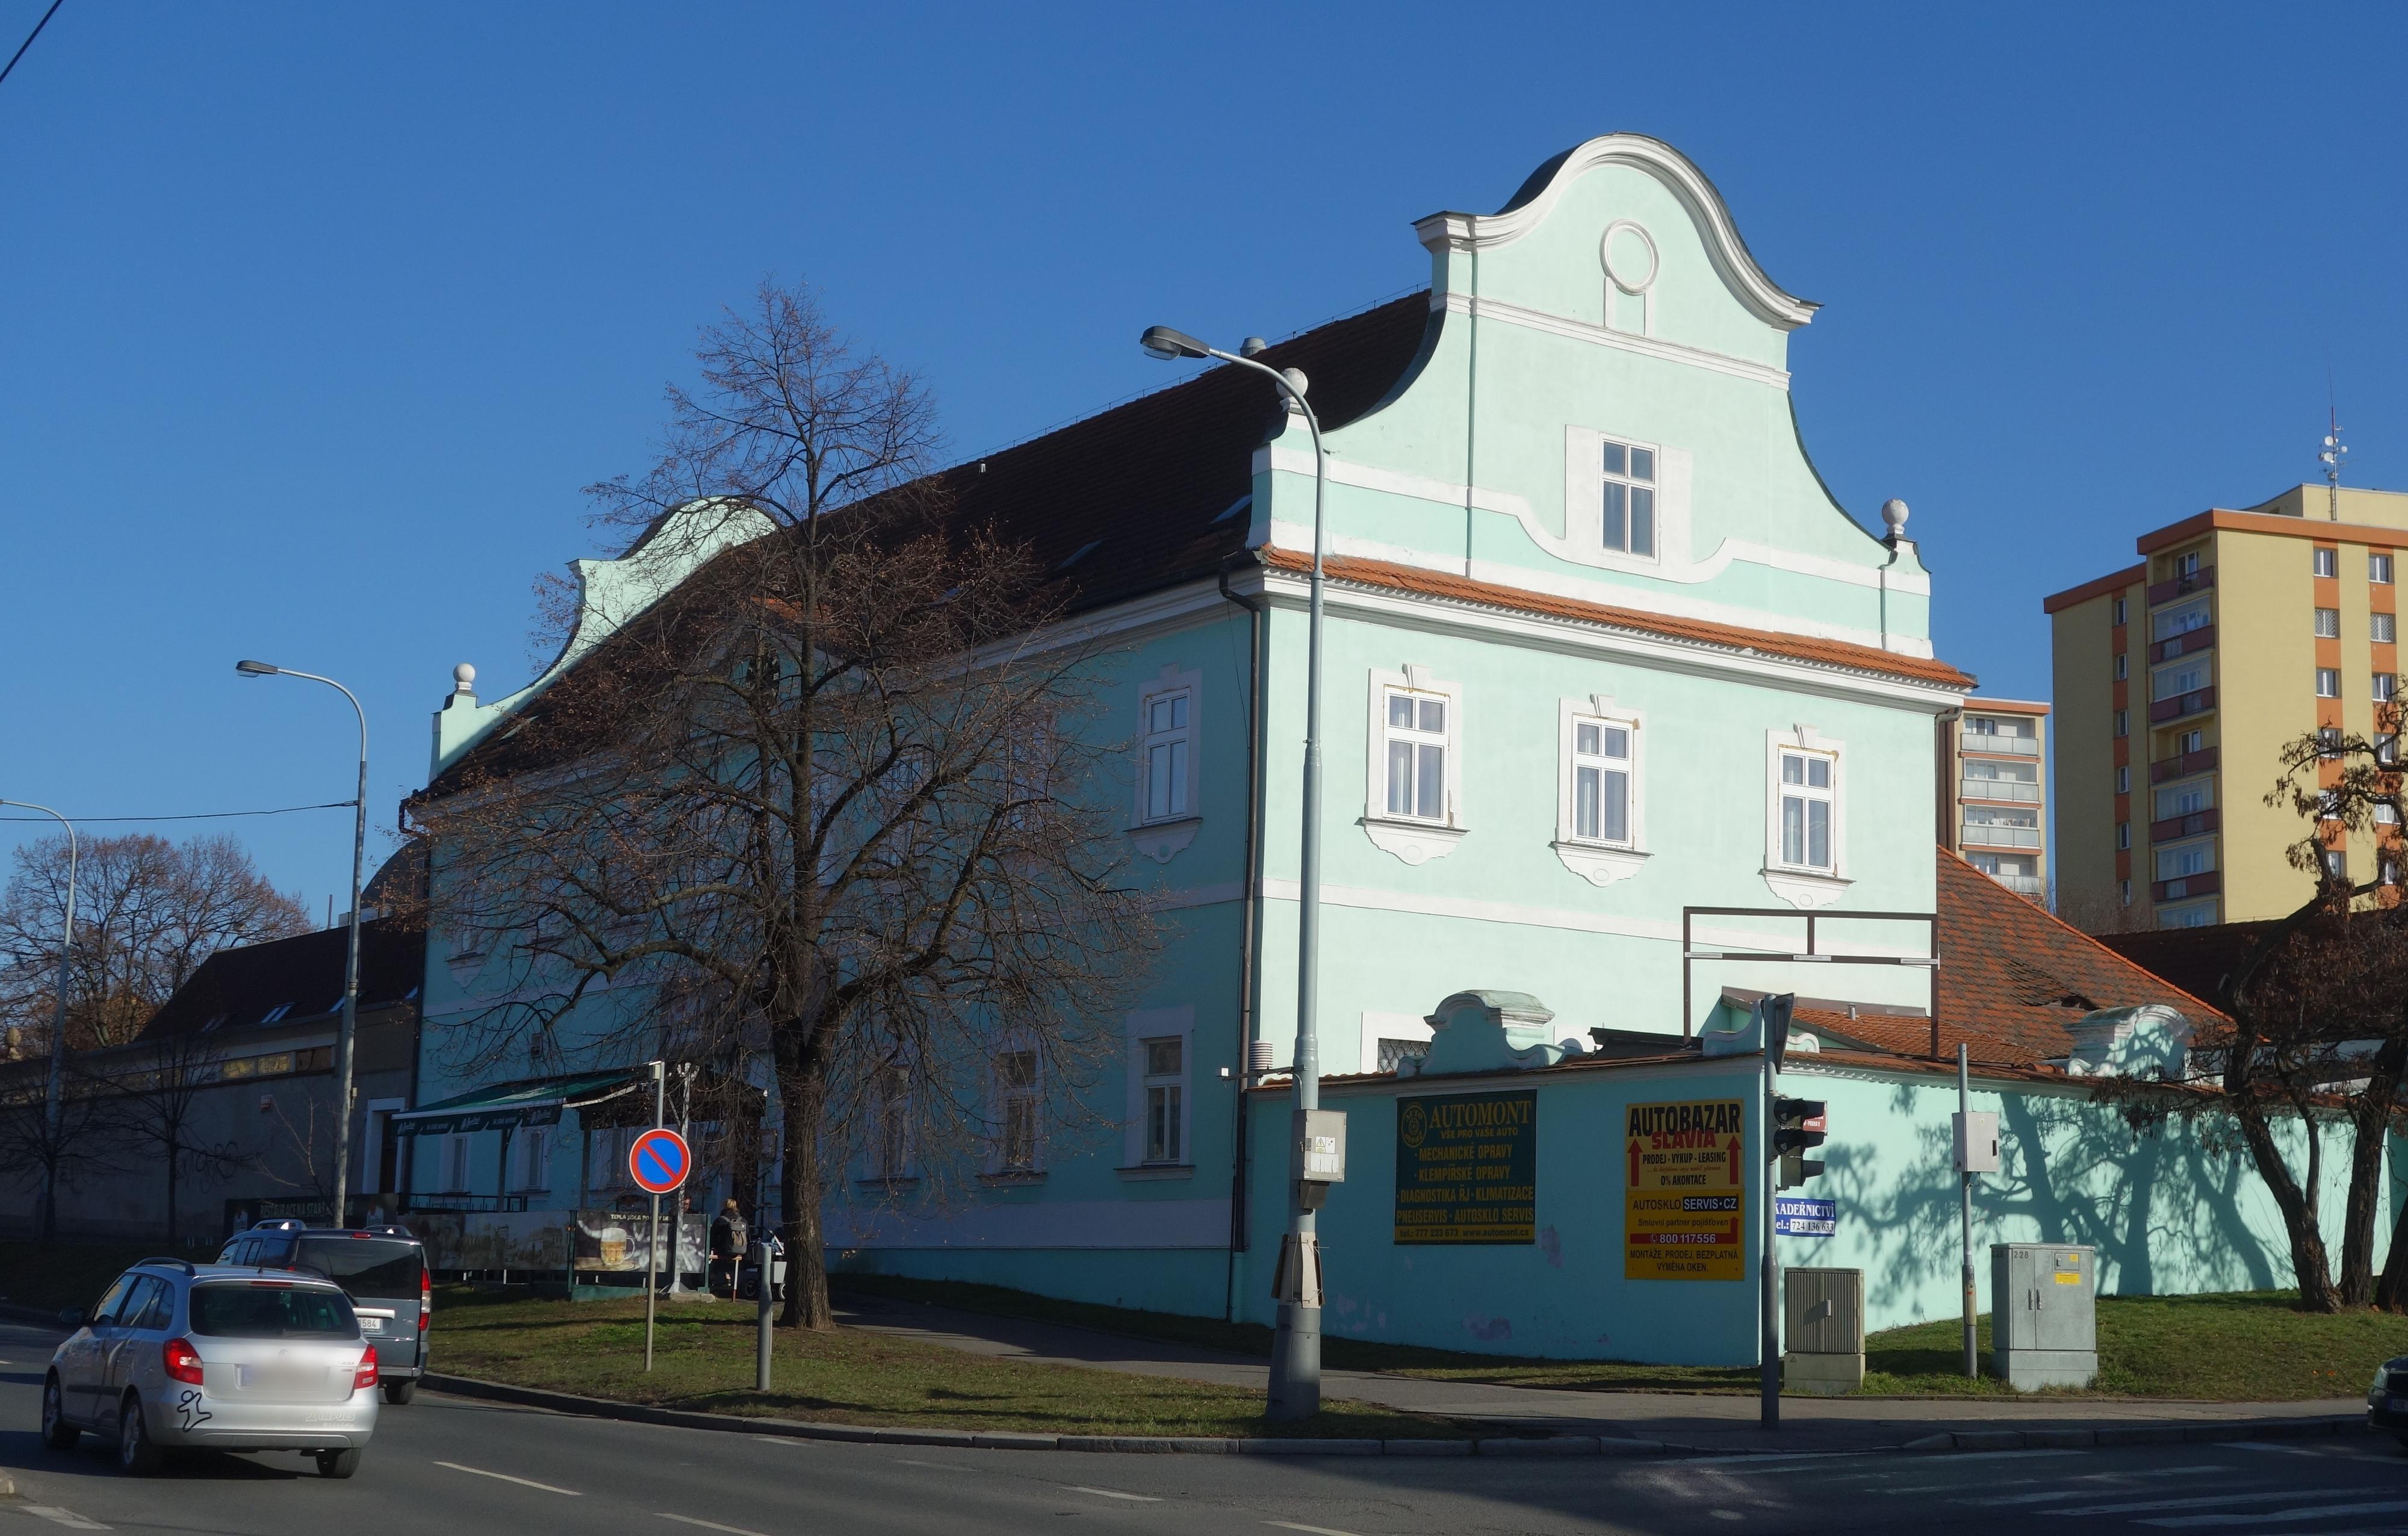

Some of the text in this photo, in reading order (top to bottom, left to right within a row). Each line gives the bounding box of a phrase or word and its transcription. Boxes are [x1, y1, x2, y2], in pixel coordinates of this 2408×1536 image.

[1430, 1100, 1531, 1128] AUTOMONT
[1628, 1104, 1740, 1137] AUTOBAZAR
[1441, 1127, 1518, 1139] VŠE PRO VAŠE AUTO
[1652, 1129, 1716, 1149] SLAVIA
[1419, 1142, 1512, 1161] MECHANICKÉ OPRAVY
[1643, 1154, 1666, 1164] PRODEJ
[1671, 1151, 1692, 1163] VÝKUP
[1698, 1151, 1726, 1163] LEASING
[1419, 1163, 1510, 1182] KLEMPÍŘSKÉ OPRAVY
[1661, 1175, 1706, 1186] 0% AKONTACE
[1401, 1188, 1456, 1203] DIAGNOSTIKA
[1476, 1186, 1533, 1201] KLIMATIZACE
[1633, 1199, 1680, 1210] AUTOSKLO
[1397, 1207, 1533, 1224] PNEUSERVIS AUTOSKLO SERVIS
[1666, 1218, 1689, 1228] partner
[1692, 1217, 1728, 1227] pojišťoven
[1776, 1219, 1834, 1232] el.: 724 136 633
[1463, 1228, 1528, 1237] www.automont.cz
[1660, 1234, 1716, 1243] 800 117556
[1696, 1249, 1738, 1259] BEZPLATNÁ
[1657, 1262, 1684, 1271] VÝMĚNA
